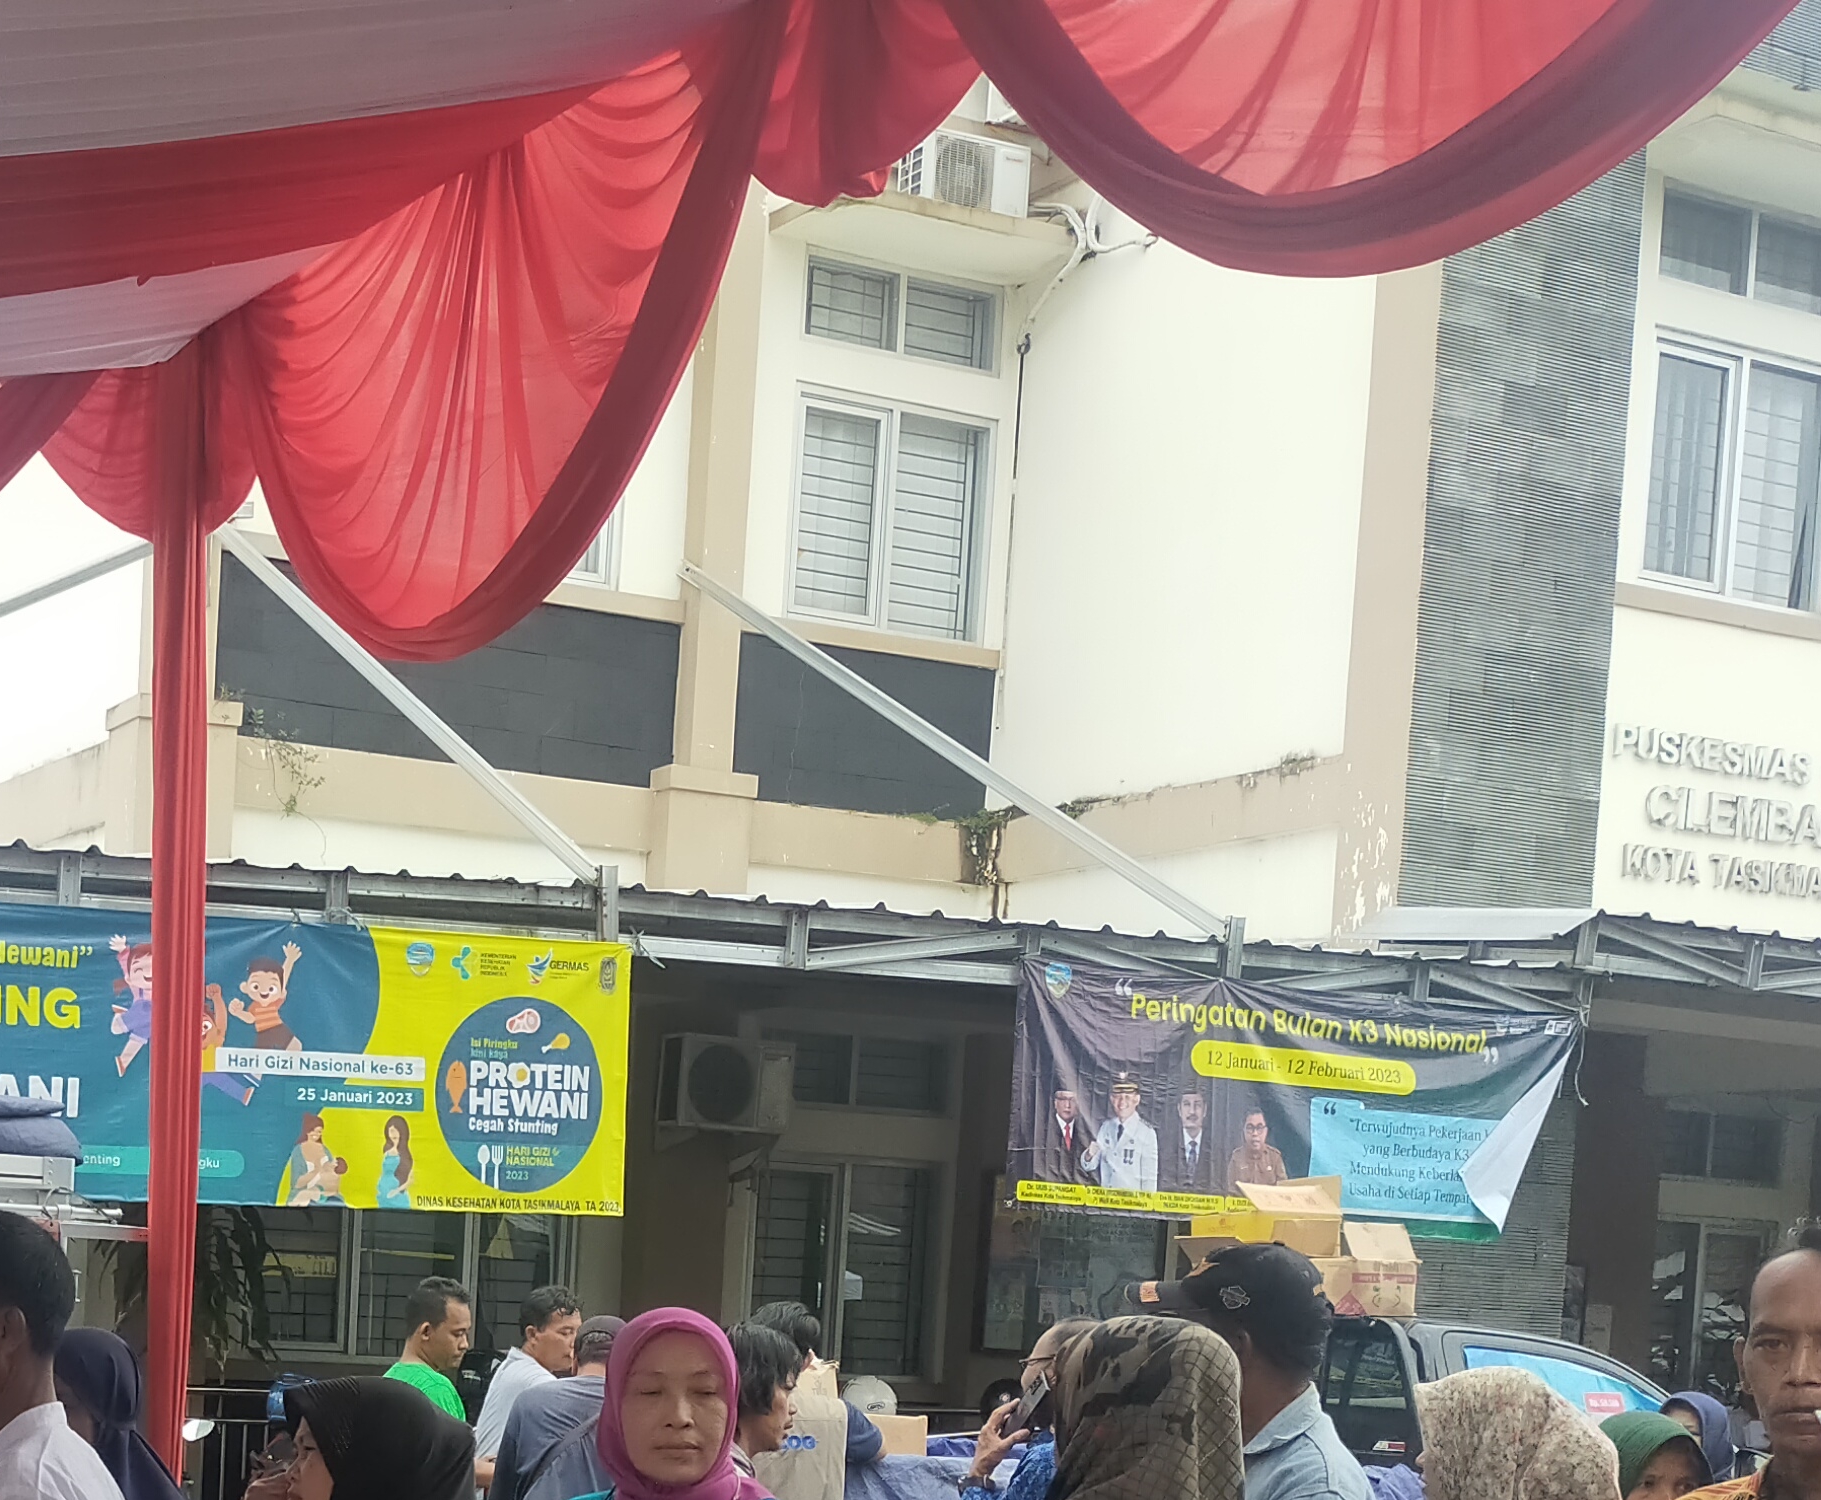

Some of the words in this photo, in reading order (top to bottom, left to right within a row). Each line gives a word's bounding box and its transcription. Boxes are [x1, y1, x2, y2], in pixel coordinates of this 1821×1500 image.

[1612, 722, 1811, 786] PUSKESMAS
[1620, 842, 1700, 886] KOTA
[549, 960, 590, 972] GERMAS
[1130, 992, 1266, 1033] Peringatan
[1272, 1009, 1343, 1041] Bulan
[1348, 1019, 1379, 1044] K3
[1384, 1022, 1487, 1054] Nasional
[228, 1054, 259, 1068] Hari
[264, 1055, 293, 1070] Gizi
[299, 1057, 365, 1074] Nasional
[370, 1060, 414, 1076] ke-63
[1207, 1050, 1223, 1066] 12
[1226, 1052, 1275, 1070] Januari
[1287, 1059, 1304, 1075] 12
[1307, 1061, 1365, 1081] Februari
[1368, 1066, 1402, 1084] 2023
[469, 1060, 590, 1092] PROTEIN
[297, 1087, 317, 1101] 25
[320, 1088, 373, 1104] Januari
[377, 1091, 413, 1105] 2023
[469, 1087, 589, 1120] HEWANI
[468, 1116, 504, 1133] Cegah
[507, 1117, 559, 1136] Stunting
[1429, 1124, 1482, 1143] Pekerjaan
[506, 1145, 530, 1156] HARI
[1363, 1144, 1390, 1158] yang
[1392, 1143, 1451, 1163] Berbudaya
[1453, 1147, 1470, 1161] K3
[505, 1155, 555, 1167] NASIONAL
[505, 1170, 529, 1181] 2023
[1350, 1161, 1416, 1182] Mendukung
[1418, 1165, 1463, 1182] Keberla
[417, 1195, 444, 1207] DINAS
[445, 1196, 497, 1209] KESEHATAN
[499, 1198, 521, 1210] KOTA
[523, 1199, 581, 1212] TASIKMALAYA
[586, 1201, 597, 1212] TA
[1349, 1182, 1381, 1198] Usaha
[1384, 1184, 1395, 1198] di
[1397, 1185, 1431, 1205] Setiap
